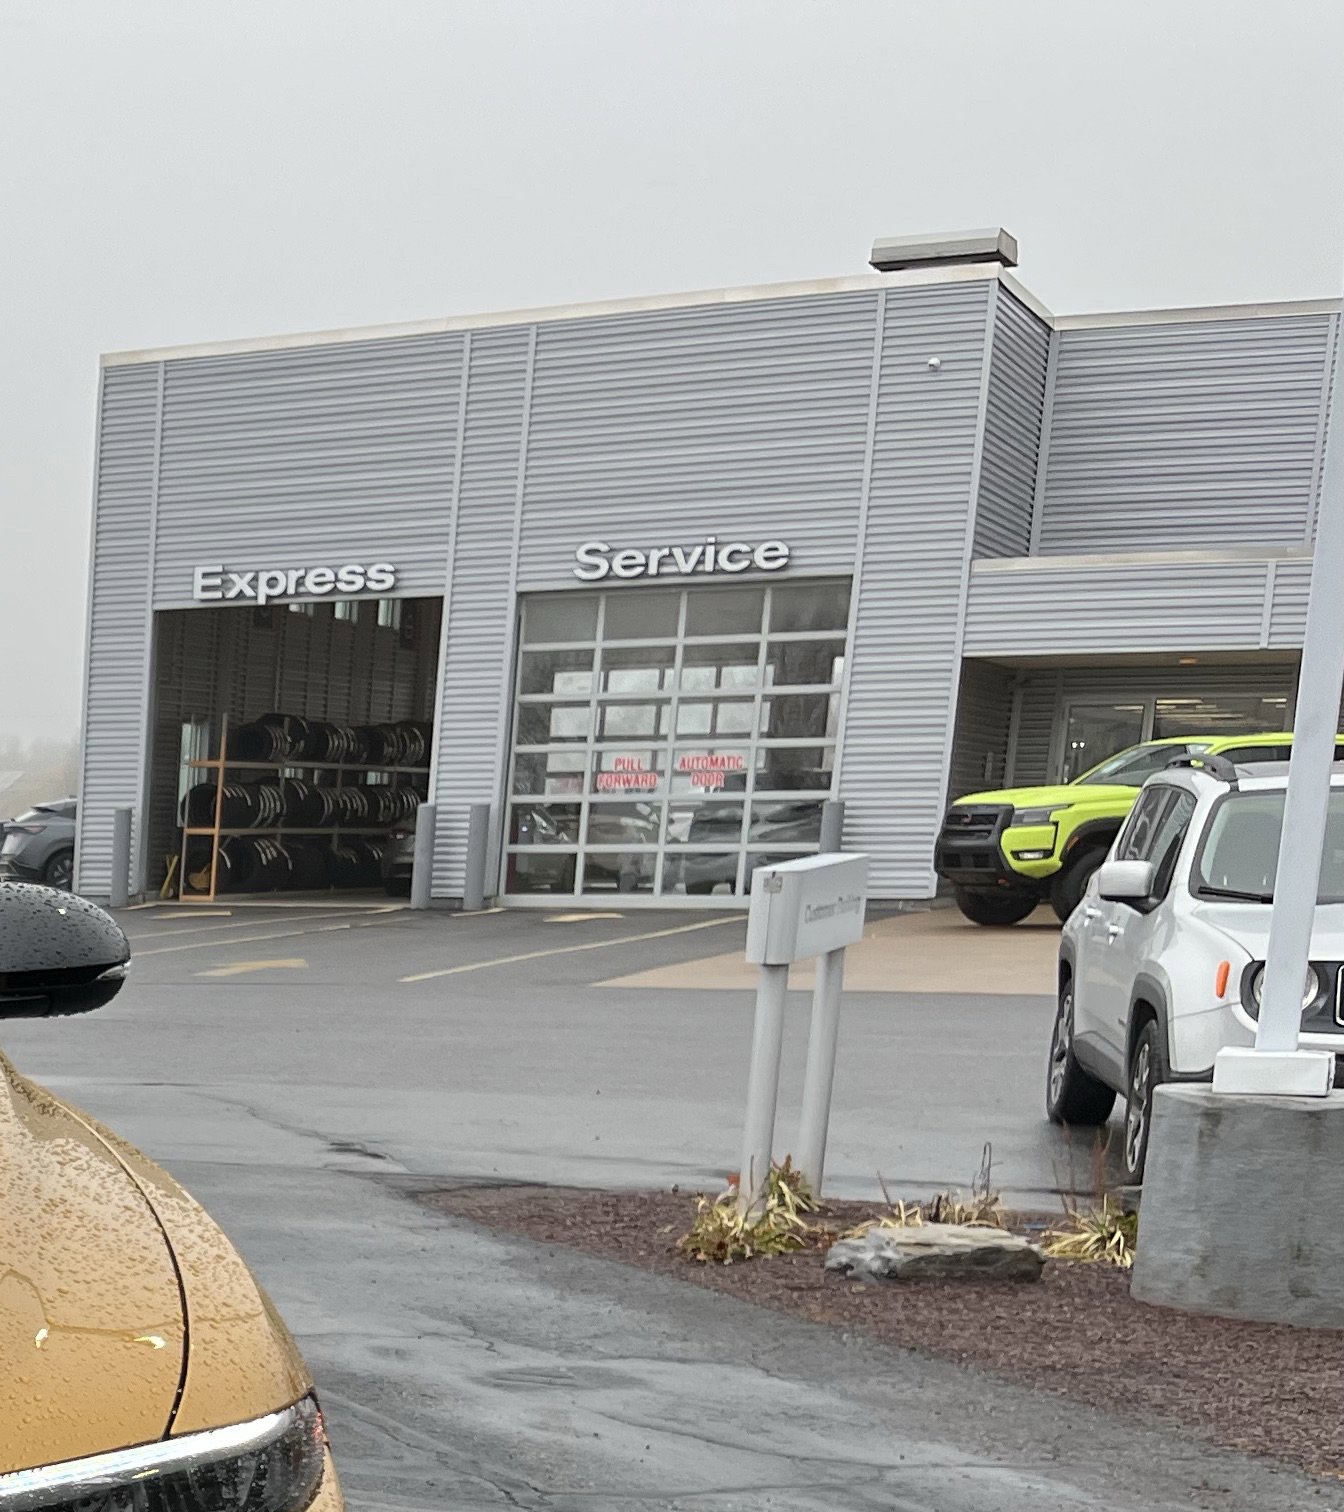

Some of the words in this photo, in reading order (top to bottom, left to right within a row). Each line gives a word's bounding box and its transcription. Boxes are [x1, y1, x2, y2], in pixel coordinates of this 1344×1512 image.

[573, 537, 790, 581] Service
[193, 563, 396, 605] Express
[614, 757, 643, 771] PULL
[679, 755, 744, 770] AUTOMATIC
[598, 773, 657, 788] FORWARD
[691, 771, 724, 788] DOOR
